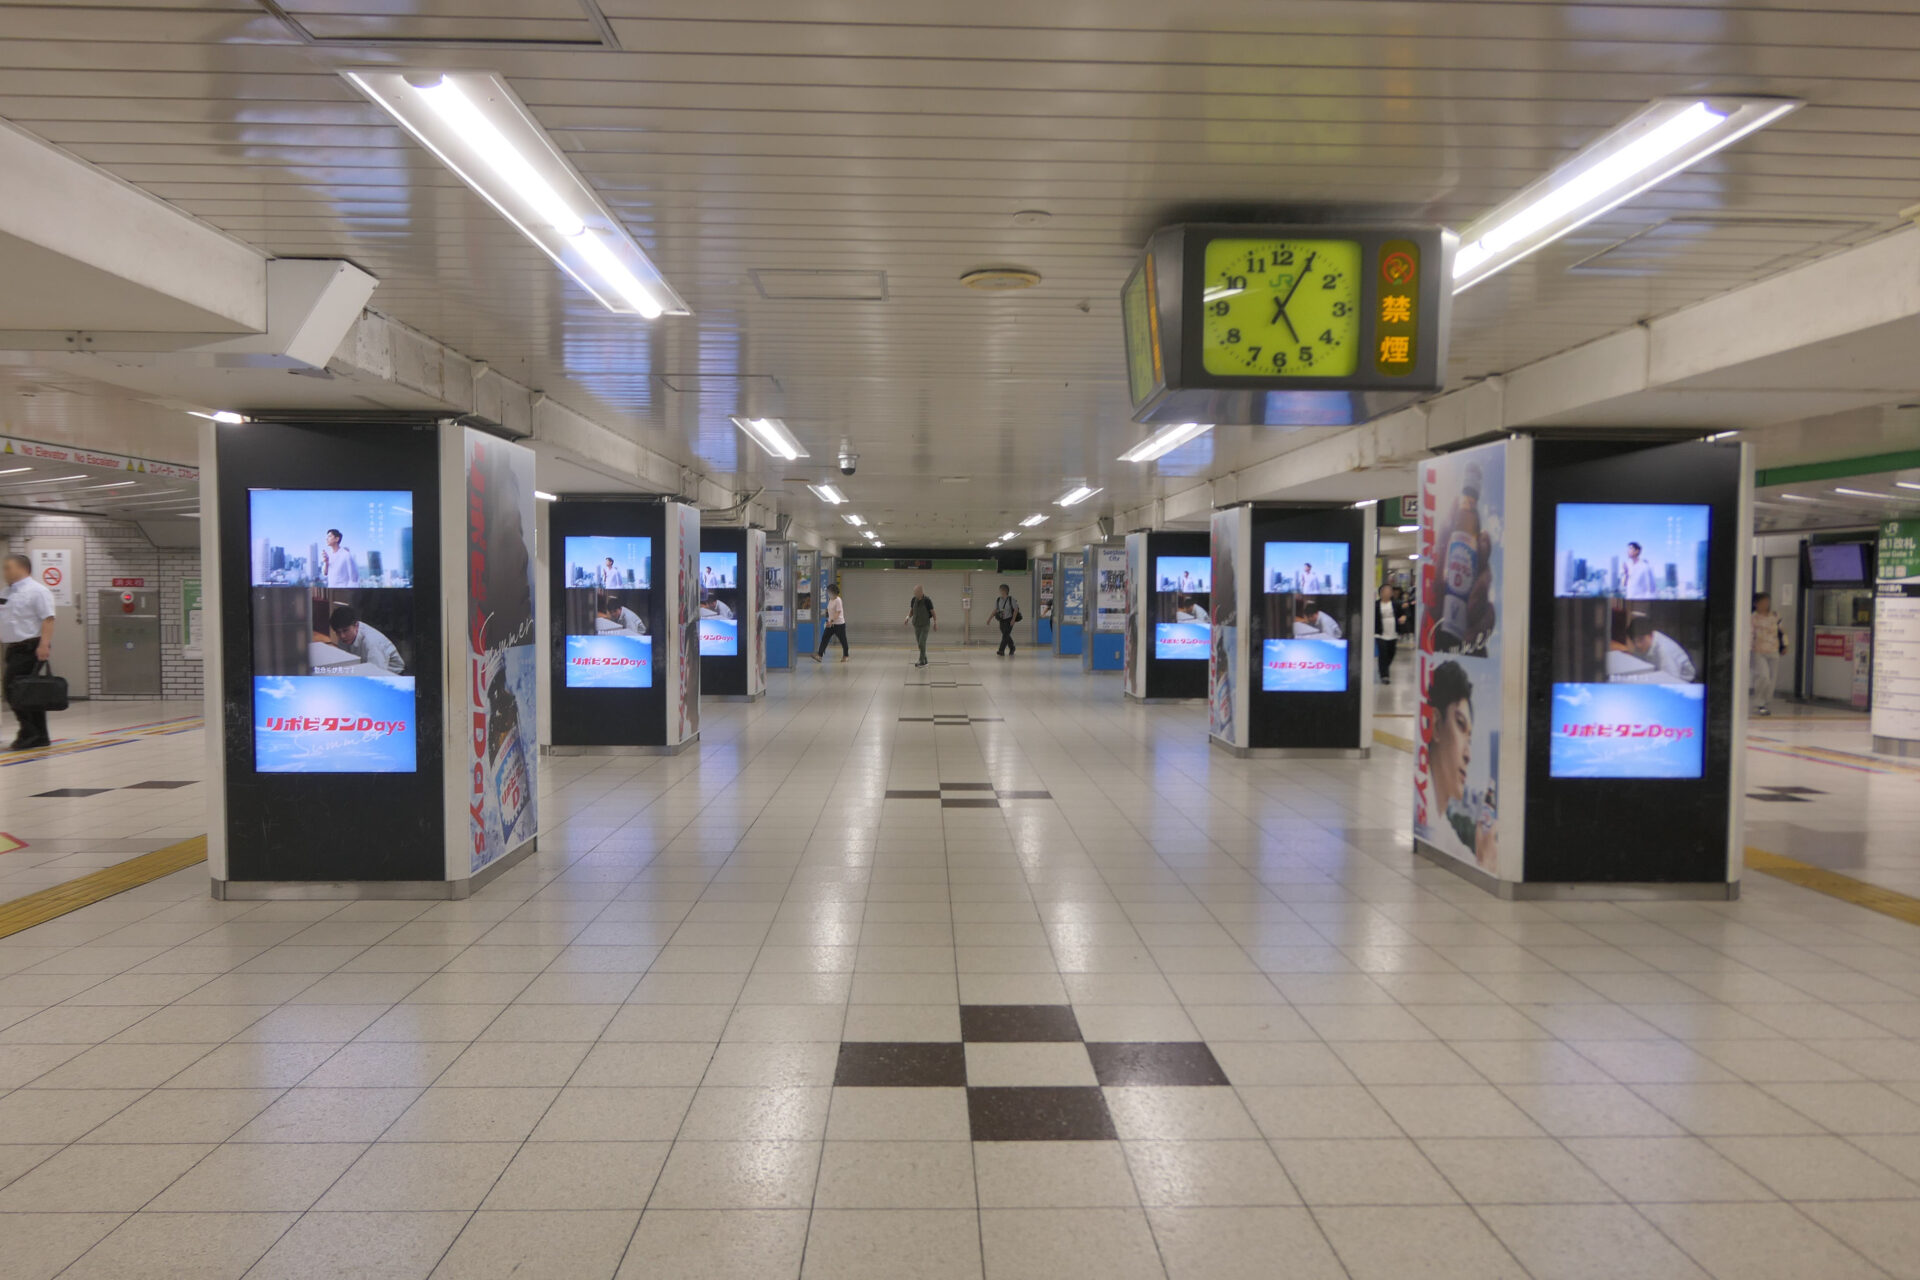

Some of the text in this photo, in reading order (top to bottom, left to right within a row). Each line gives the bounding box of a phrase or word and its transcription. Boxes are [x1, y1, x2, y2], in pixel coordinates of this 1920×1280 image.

[1247, 258, 1266, 273] 11
[1271, 250, 1294, 266] 12
[1226, 275, 1247, 290] 10
[1269, 273, 1294, 288] JR
[1322, 274, 1337, 290] 2
[1215, 301, 1230, 317] 9
[1332, 301, 1346, 318] 3
[1226, 328, 1241, 344] 8
[1318, 328, 1334, 345] 4
[1380, 294, 1411, 363] 禁煙
[1248, 346, 1262, 362] 7
[1272, 351, 1287, 368] 6
[1299, 346, 1313, 362] 5
[21, 444, 120, 468] No Elevator No Escalator
[572, 656, 648, 668] リポビタンDays
[265, 715, 406, 736] リポビタンDays
[1562, 722, 1694, 742] リポビタンDays
